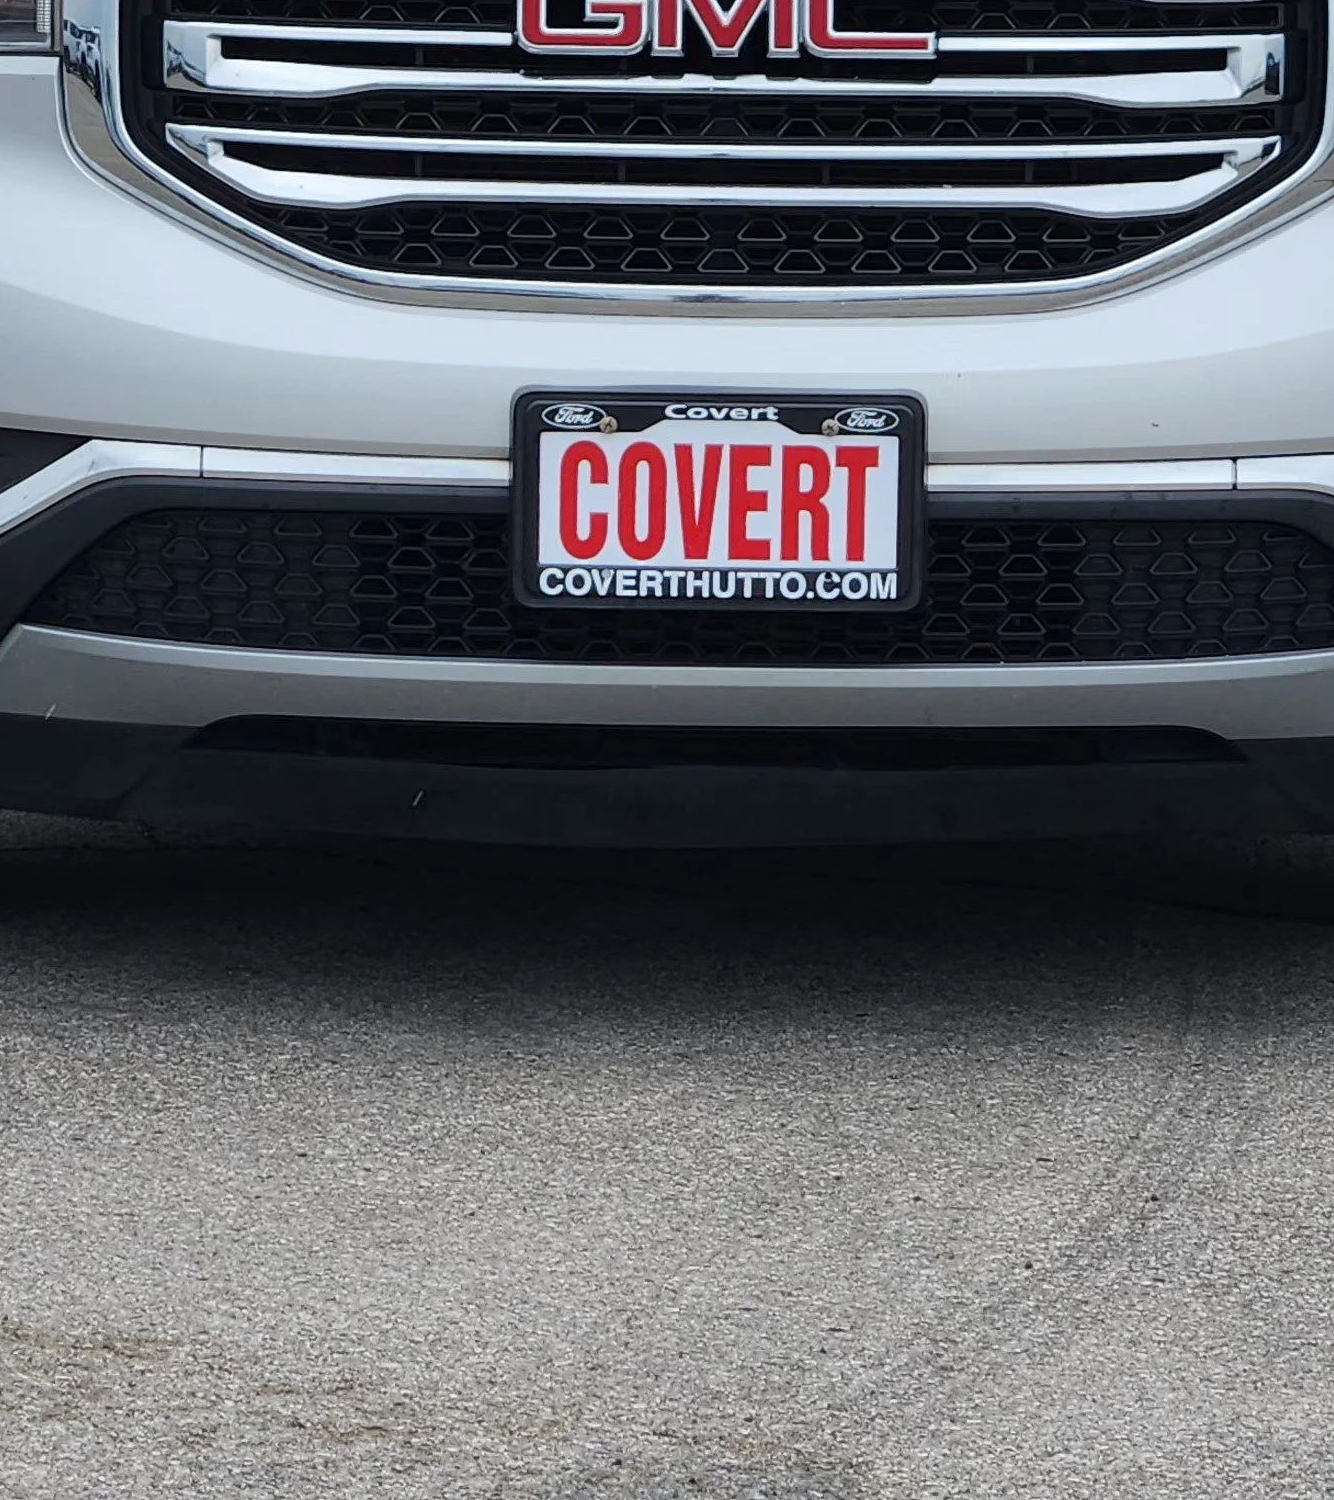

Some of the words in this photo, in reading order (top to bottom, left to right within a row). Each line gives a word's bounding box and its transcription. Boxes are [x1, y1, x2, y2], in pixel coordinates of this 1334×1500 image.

[555, 406, 594, 425] Ford
[664, 404, 780, 421] Covert
[848, 410, 886, 428] Ford
[559, 440, 880, 561] COVERT
[538, 567, 898, 599] COVERTHUTTO.COM
